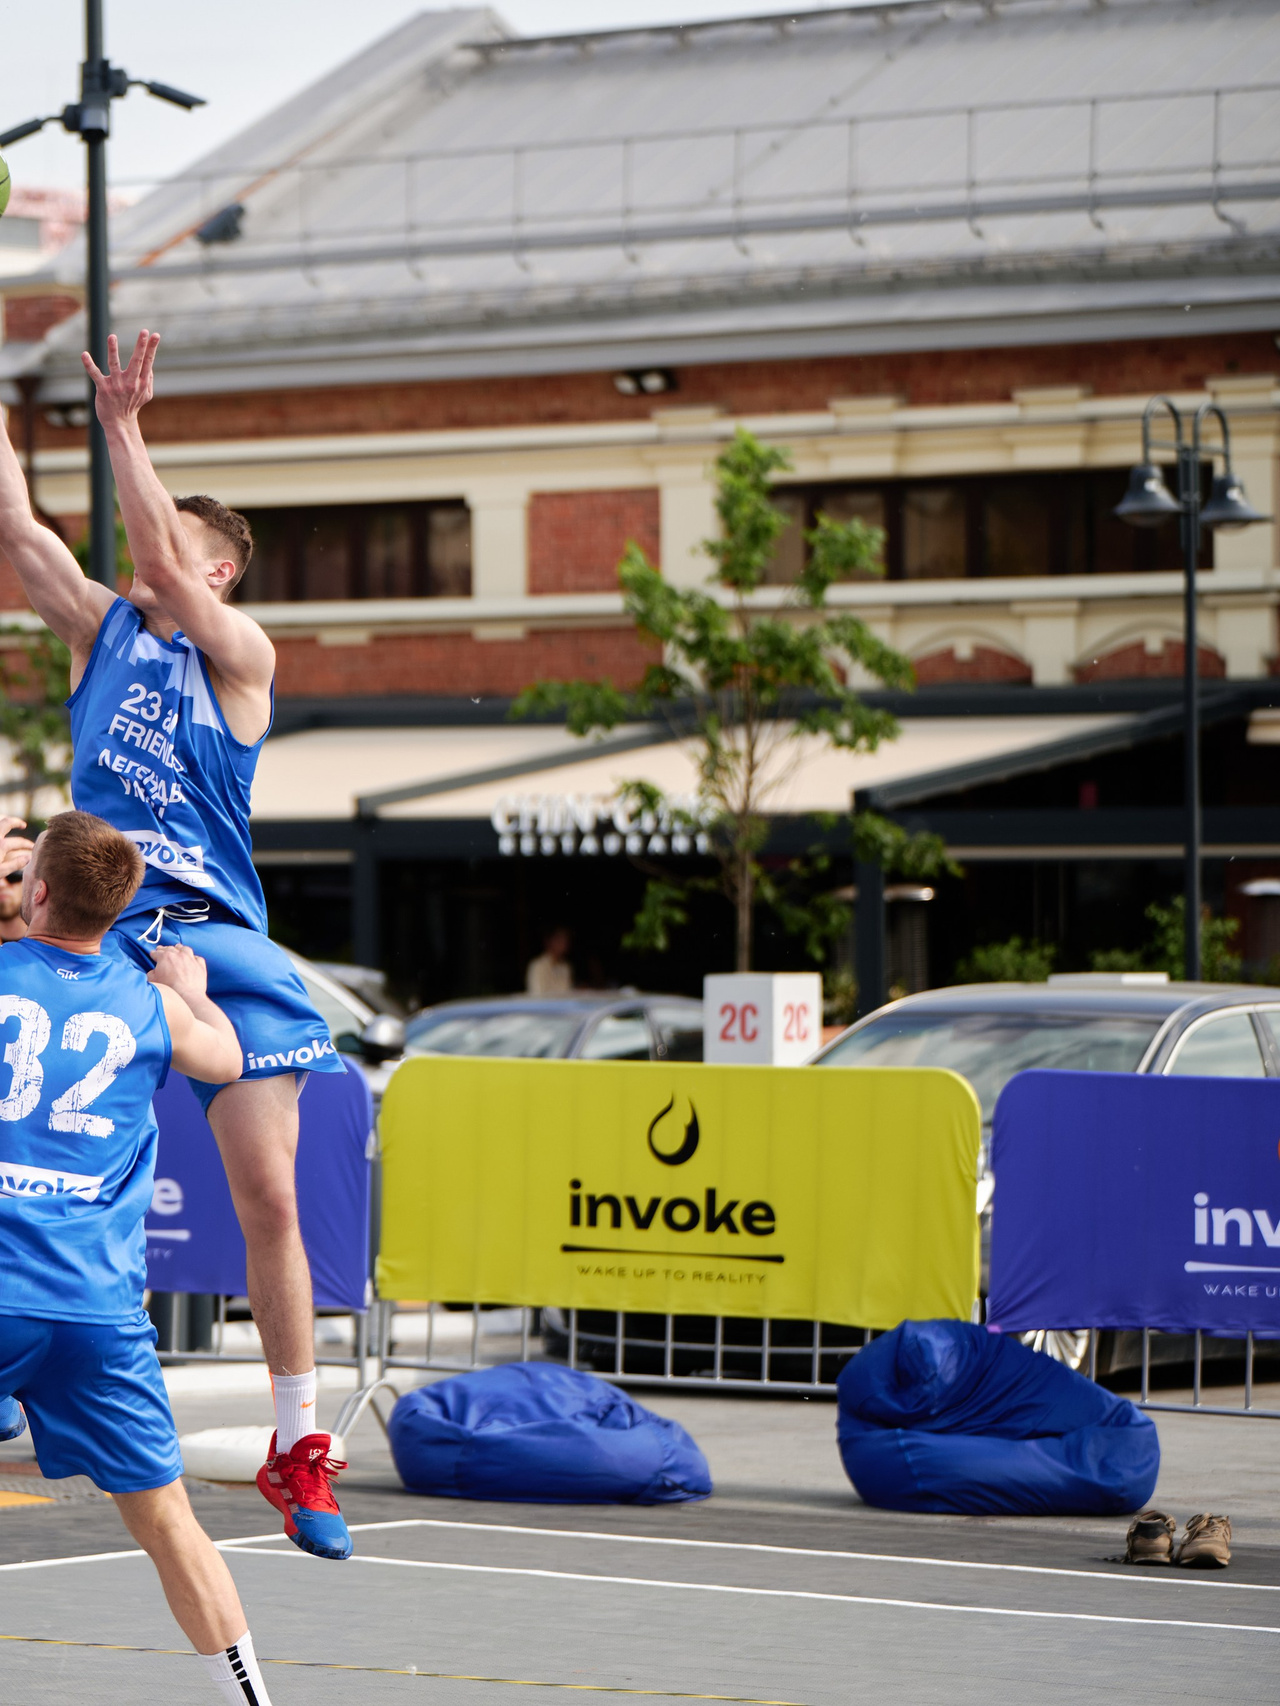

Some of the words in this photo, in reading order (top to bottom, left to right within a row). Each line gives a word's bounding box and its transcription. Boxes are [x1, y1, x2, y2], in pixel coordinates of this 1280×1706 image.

[119, 682, 163, 722] 23
[718, 1003, 759, 1042] 2C
[783, 1002, 810, 1042] 2C
[246, 1039, 337, 1070] invok
[569, 1177, 777, 1236] invoke
[577, 1264, 627, 1278] WAKE
[633, 1267, 656, 1279] UP
[663, 1268, 685, 1281] TO
[692, 1269, 767, 1284] REALITY
[1203, 1283, 1258, 1297] WAKE
[1265, 1285, 1280, 1298] U
